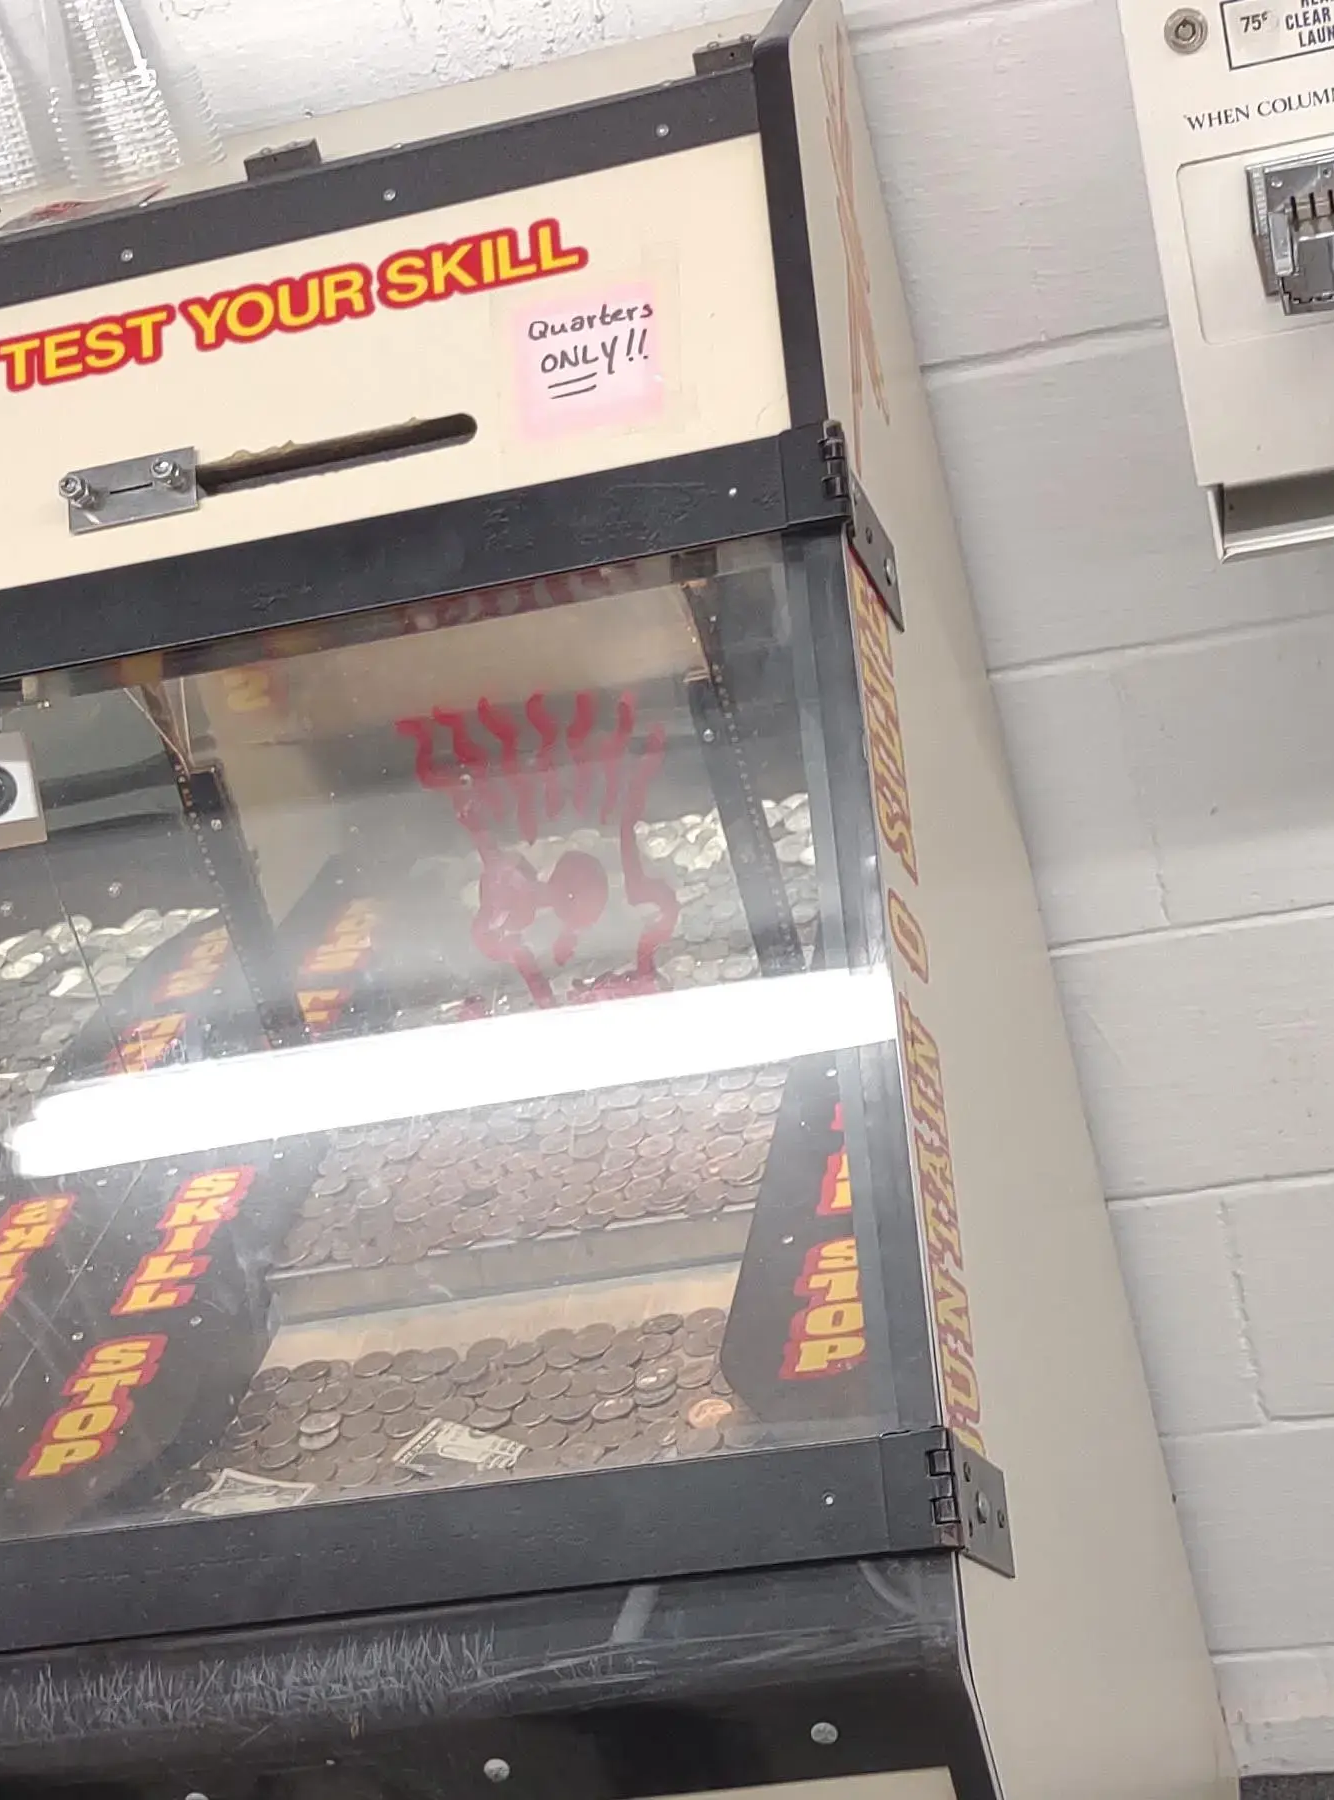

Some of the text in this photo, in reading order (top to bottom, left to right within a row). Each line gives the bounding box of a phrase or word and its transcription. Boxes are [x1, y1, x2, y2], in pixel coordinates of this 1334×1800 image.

[1285, 6, 1331, 30] CLEAR
[1186, 105, 1250, 131] WHEN
[186, 268, 369, 349] YOUR
[382, 221, 584, 307] SKILL
[528, 303, 653, 341] Quarters
[541, 327, 648, 375] ONLY!!
[888, 888, 929, 984] O
[117, 1168, 245, 1314] SKILL
[899, 992, 986, 1456] UNTAIN
[793, 1238, 866, 1374] STOP
[25, 1337, 155, 1479] STOP
